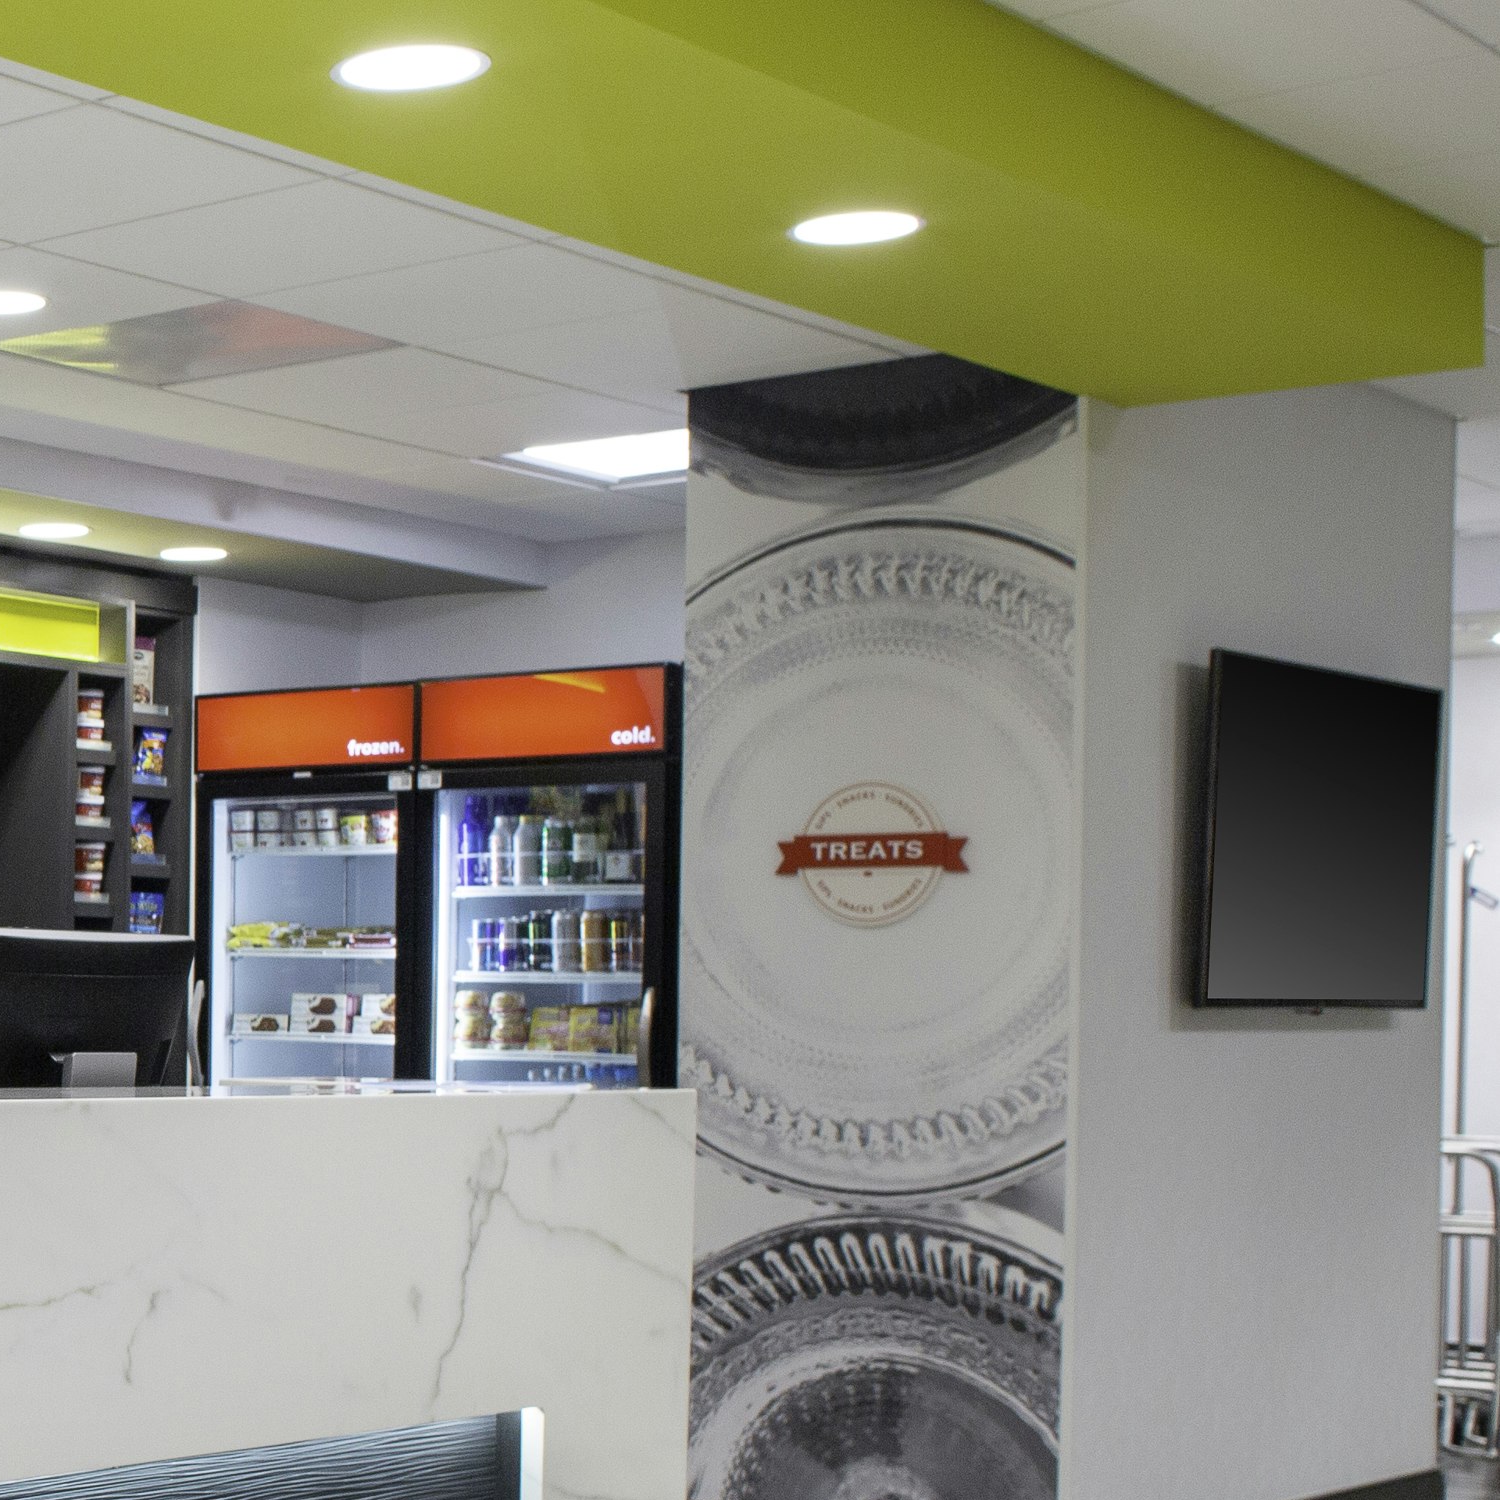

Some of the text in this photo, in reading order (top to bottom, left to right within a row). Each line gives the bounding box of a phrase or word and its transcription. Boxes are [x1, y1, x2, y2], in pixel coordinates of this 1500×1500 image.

[610, 724, 656, 746] cold.
[346, 738, 405, 757] frozen.
[810, 840, 924, 861] TREATS
